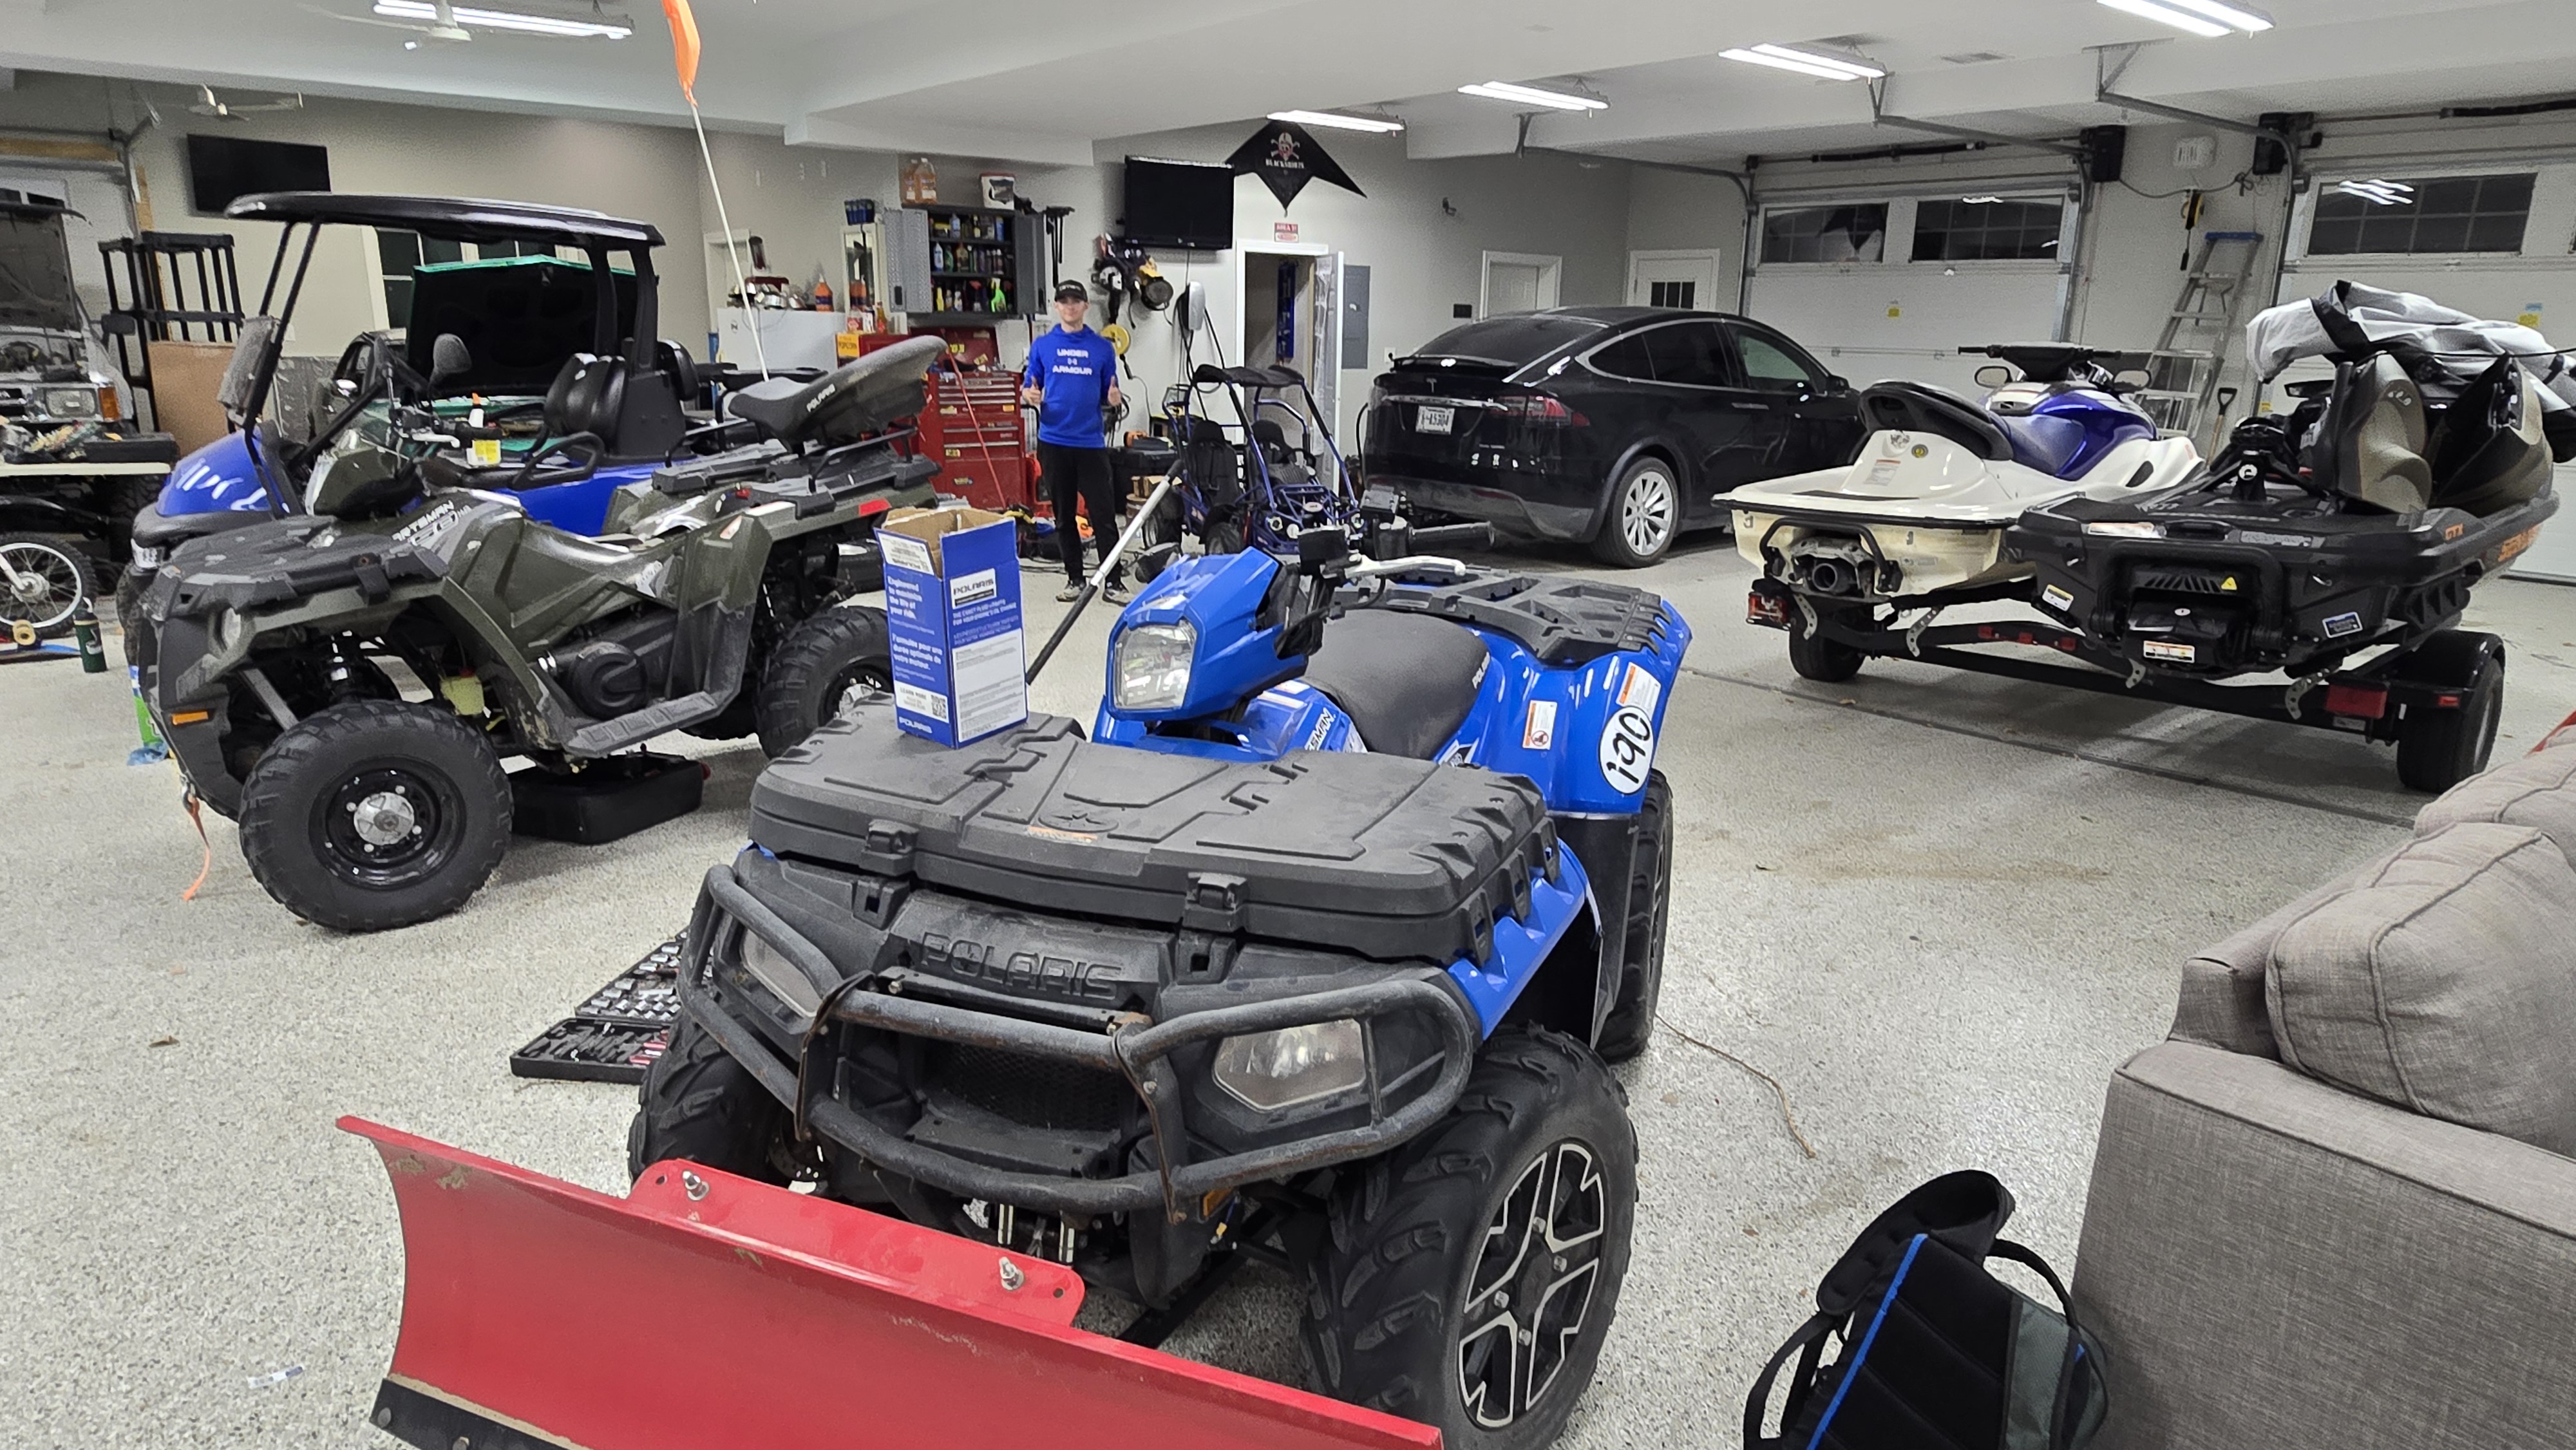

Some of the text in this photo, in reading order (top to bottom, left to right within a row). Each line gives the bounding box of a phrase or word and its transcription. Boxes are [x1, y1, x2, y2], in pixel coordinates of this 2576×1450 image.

[1056, 348, 1089, 358] UNDER
[1052, 365, 1093, 375] ARMOUR
[806, 384, 836, 413] POLARIS
[953, 578, 994, 596] POLARIS
[899, 717, 933, 733] POLARIS
[1304, 707, 1335, 751] SMAN
[1606, 712, 1650, 784] 190
[920, 931, 1122, 1001] POLARIS
